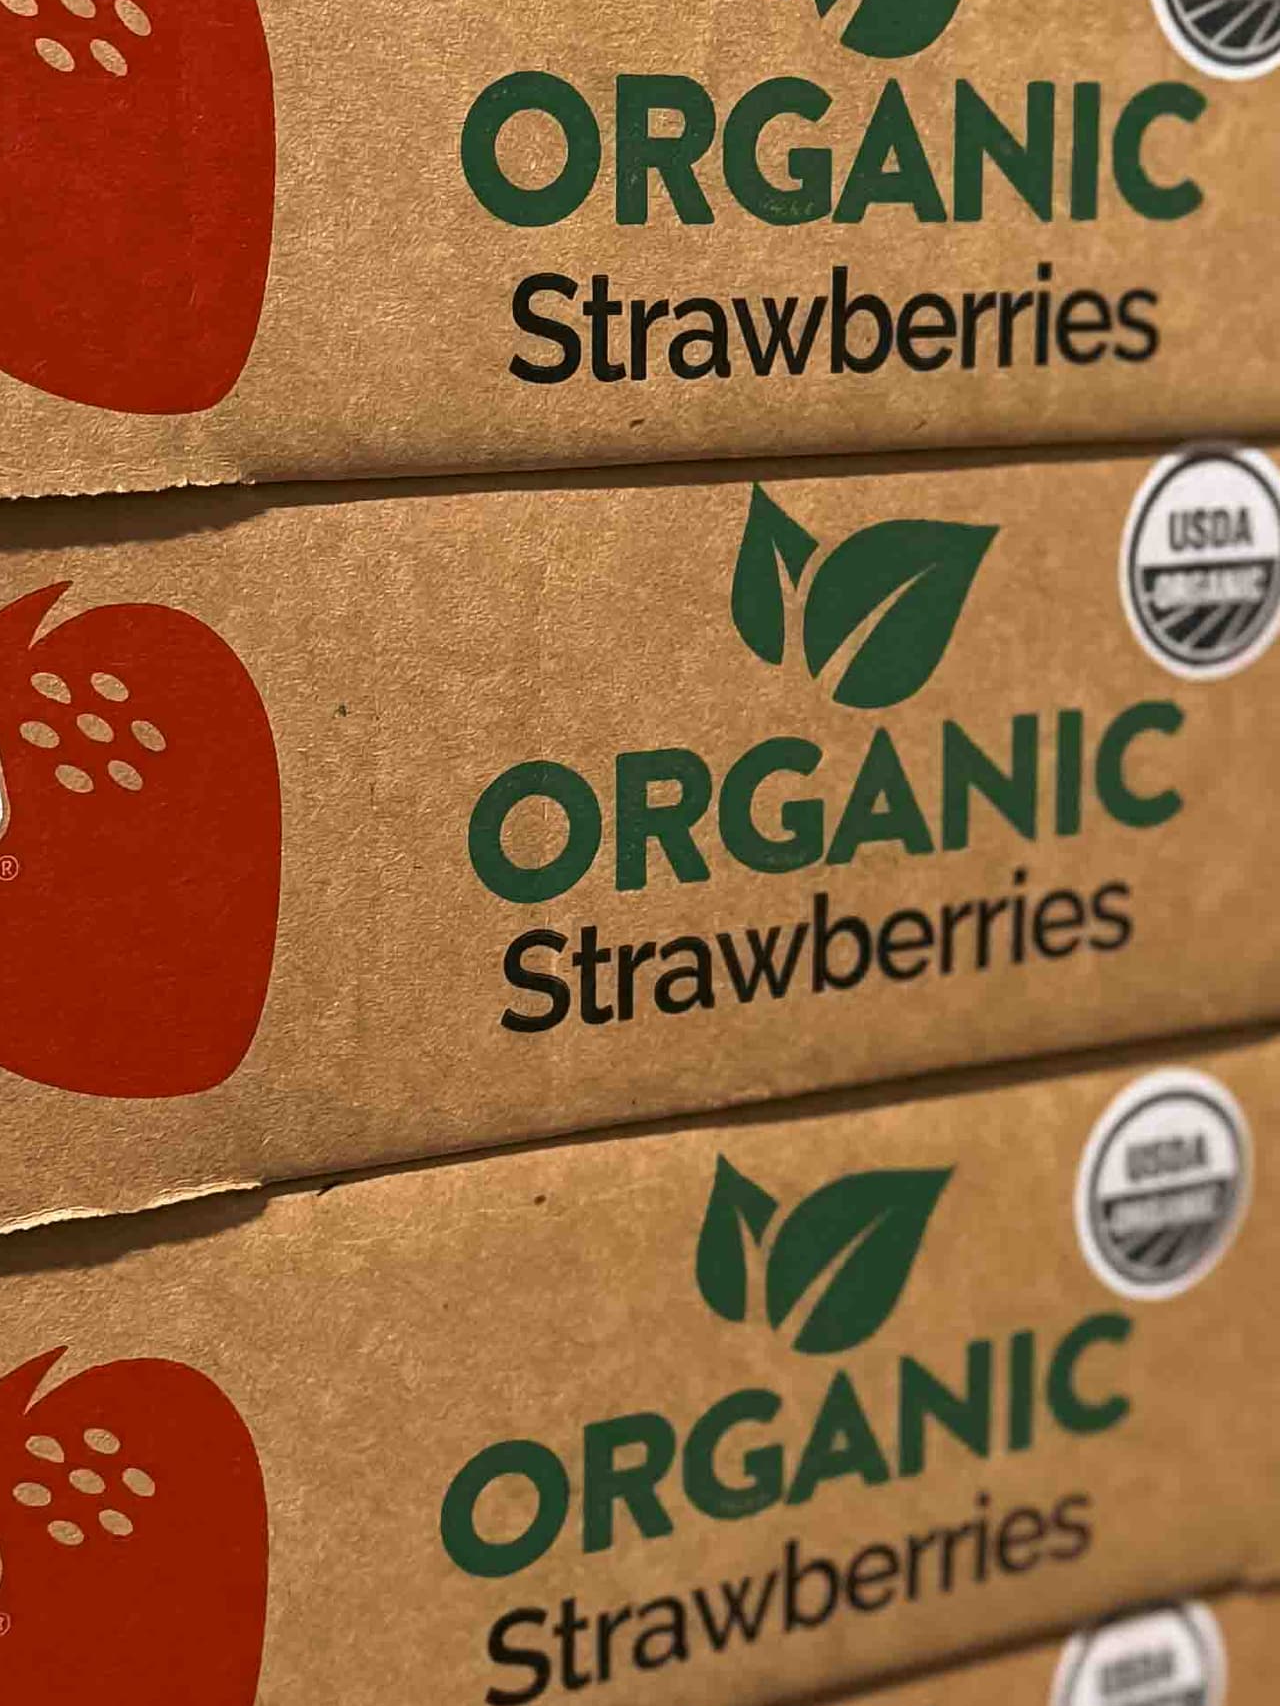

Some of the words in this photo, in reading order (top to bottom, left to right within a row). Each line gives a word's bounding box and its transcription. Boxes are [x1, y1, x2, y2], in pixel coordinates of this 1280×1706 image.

[459, 70, 1208, 228] ORGANIC
[507, 263, 1160, 385] Strawberries
[1168, 506, 1254, 553] USDA
[467, 700, 1184, 905] ORGANIC
[500, 868, 1134, 1034] Strawberries
[439, 1313, 1136, 1579] ORGANIC
